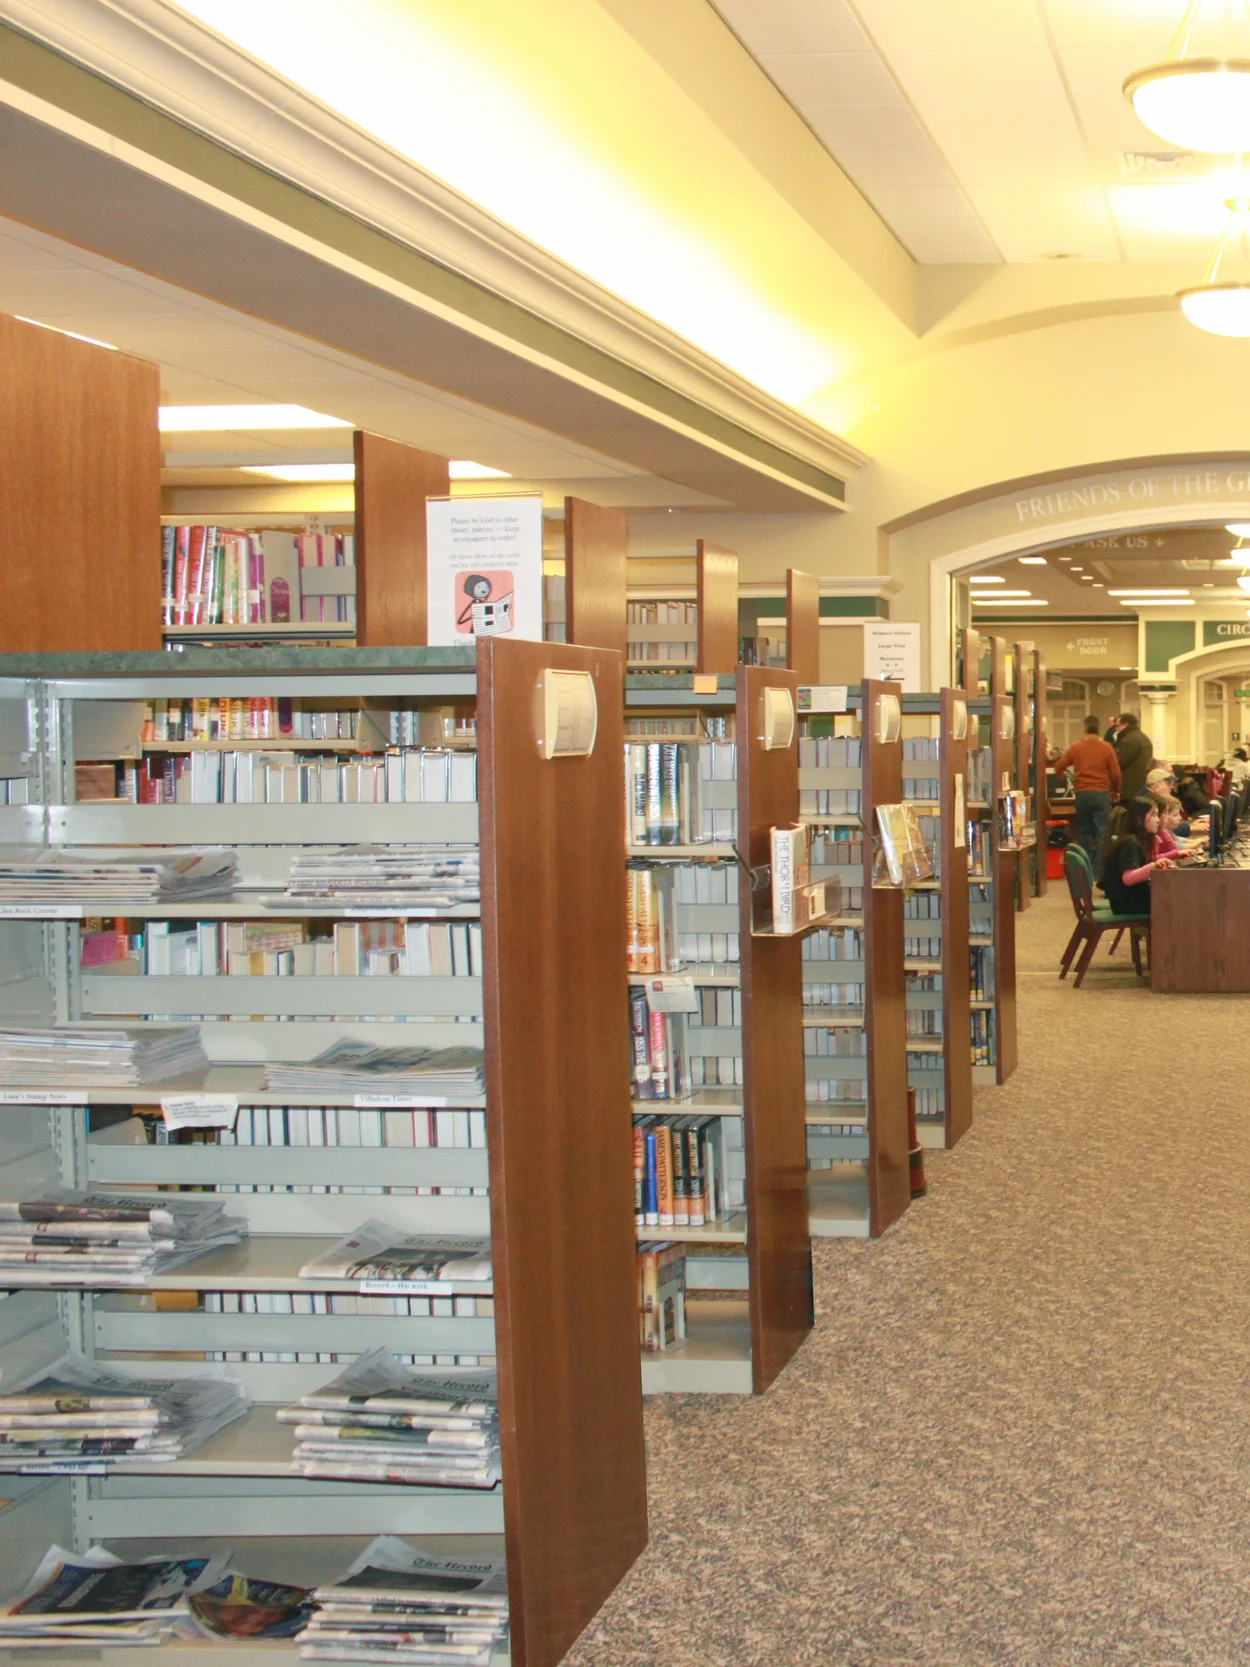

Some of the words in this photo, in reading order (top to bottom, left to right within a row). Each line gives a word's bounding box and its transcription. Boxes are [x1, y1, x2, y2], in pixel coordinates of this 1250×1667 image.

[1015, 482, 1120, 522] FRIENDS
[1128, 477, 1160, 499] OF
[1167, 472, 1219, 495] THE
[1084, 536, 1120, 548] ASK
[1126, 536, 1148, 548] US
[453, 639, 475, 647] Thank
[1076, 638, 1109, 646] FRONT
[1079, 646, 1108, 655] DOOR
[780, 836, 789, 852] THE
[780, 856, 790, 889] THORN
[15, 905, 31, 914] Rock
[781, 892, 790, 914] BIRD
[657, 1131, 666, 1156] JAMES
[659, 1156, 667, 1200] PATTERSON
[413, 1558, 442, 1567] The
[444, 1561, 492, 1571] Record
